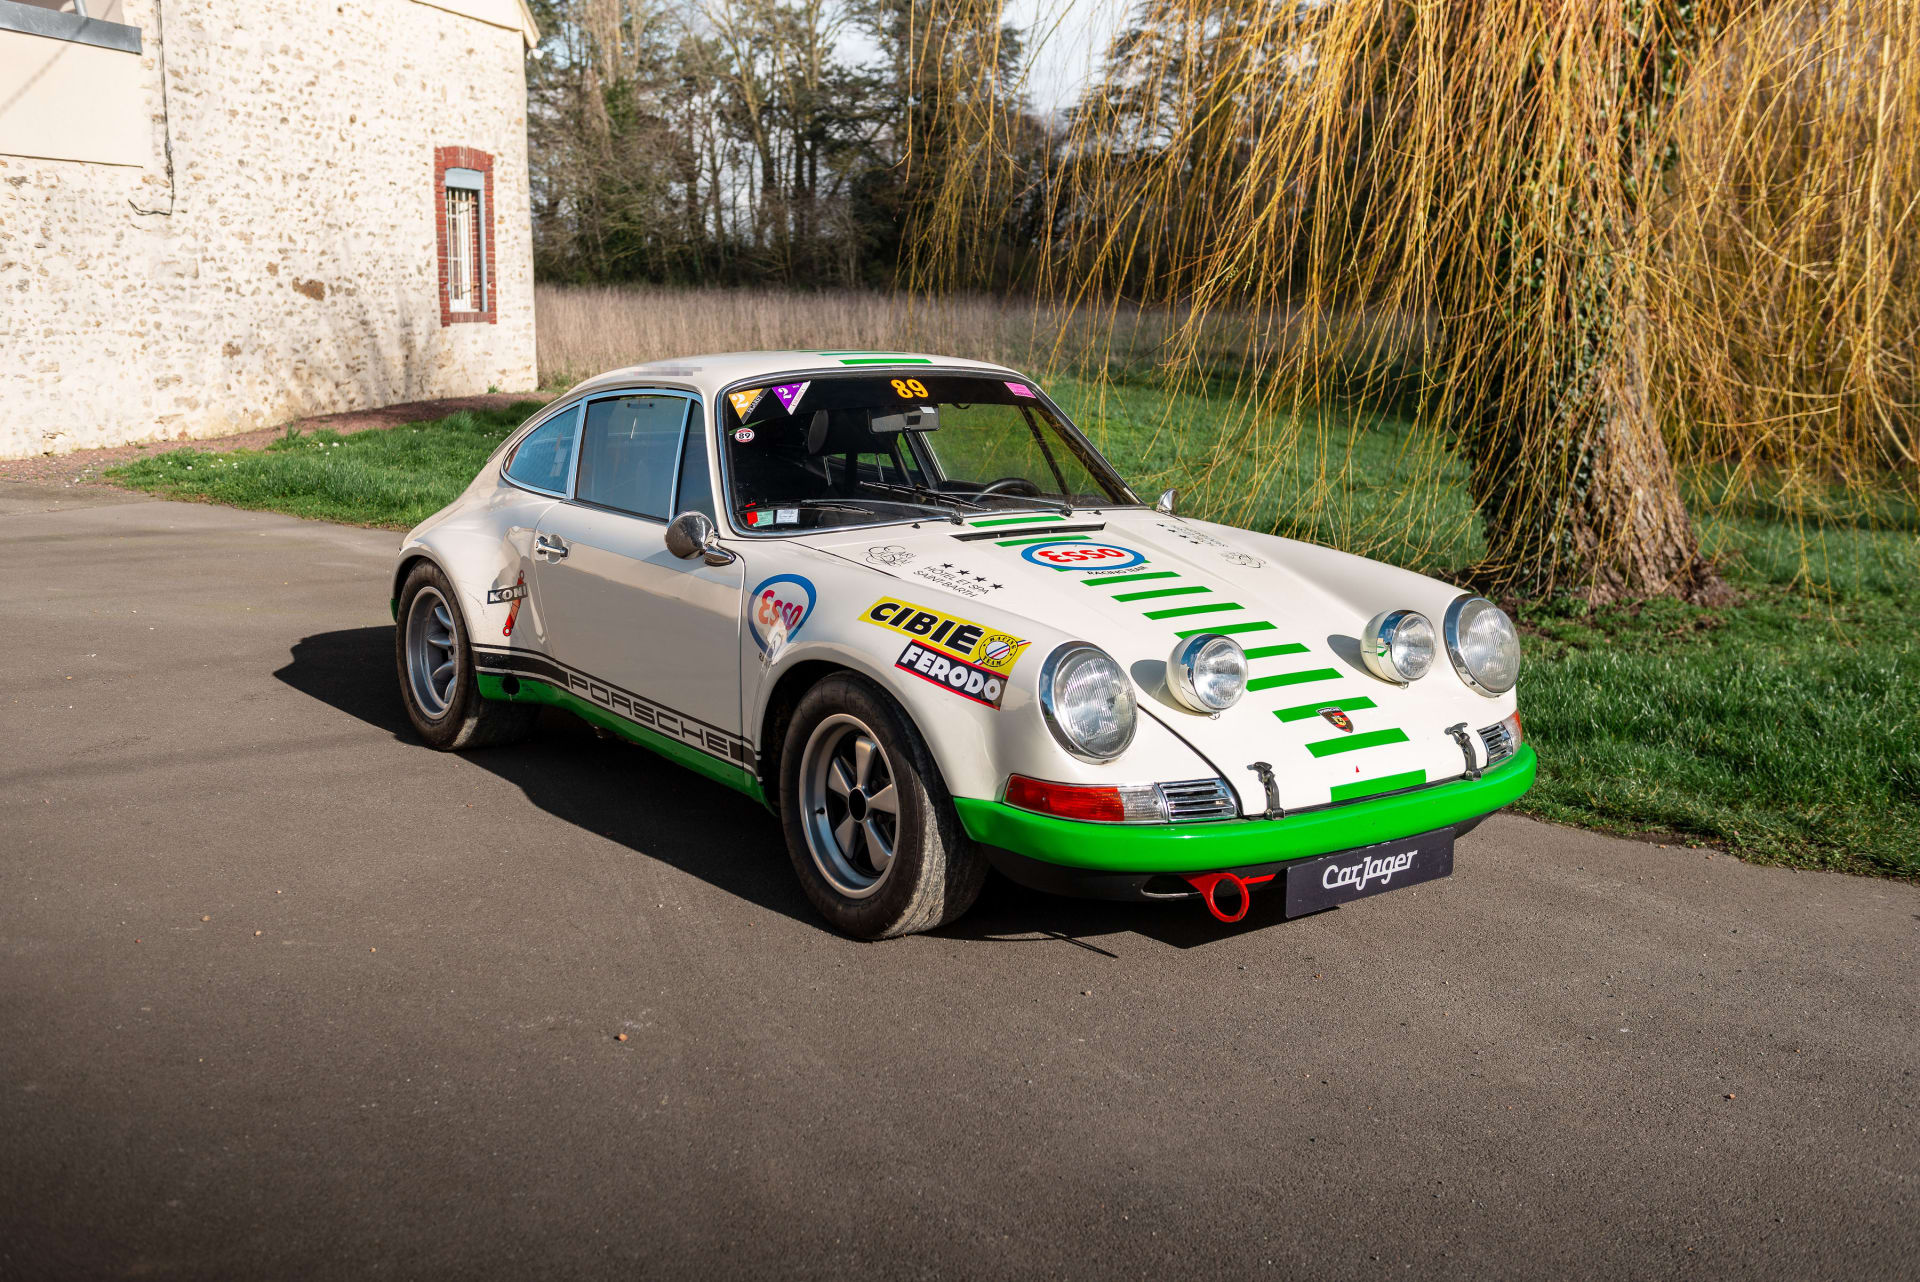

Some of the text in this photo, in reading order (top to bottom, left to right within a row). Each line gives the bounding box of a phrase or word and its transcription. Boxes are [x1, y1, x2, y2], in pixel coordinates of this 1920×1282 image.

[890, 378, 929, 399] 89
[731, 393, 749, 409] 2
[738, 432, 751, 440] 89
[489, 585, 528, 602] KONI
[870, 602, 985, 655] CIBIÉ
[989, 636, 1017, 650] RACING
[983, 655, 1001, 666] TEAM
[900, 644, 1001, 701] FERODO
[569, 673, 731, 758] PORSCHE
[1322, 850, 1419, 891] CarJager
